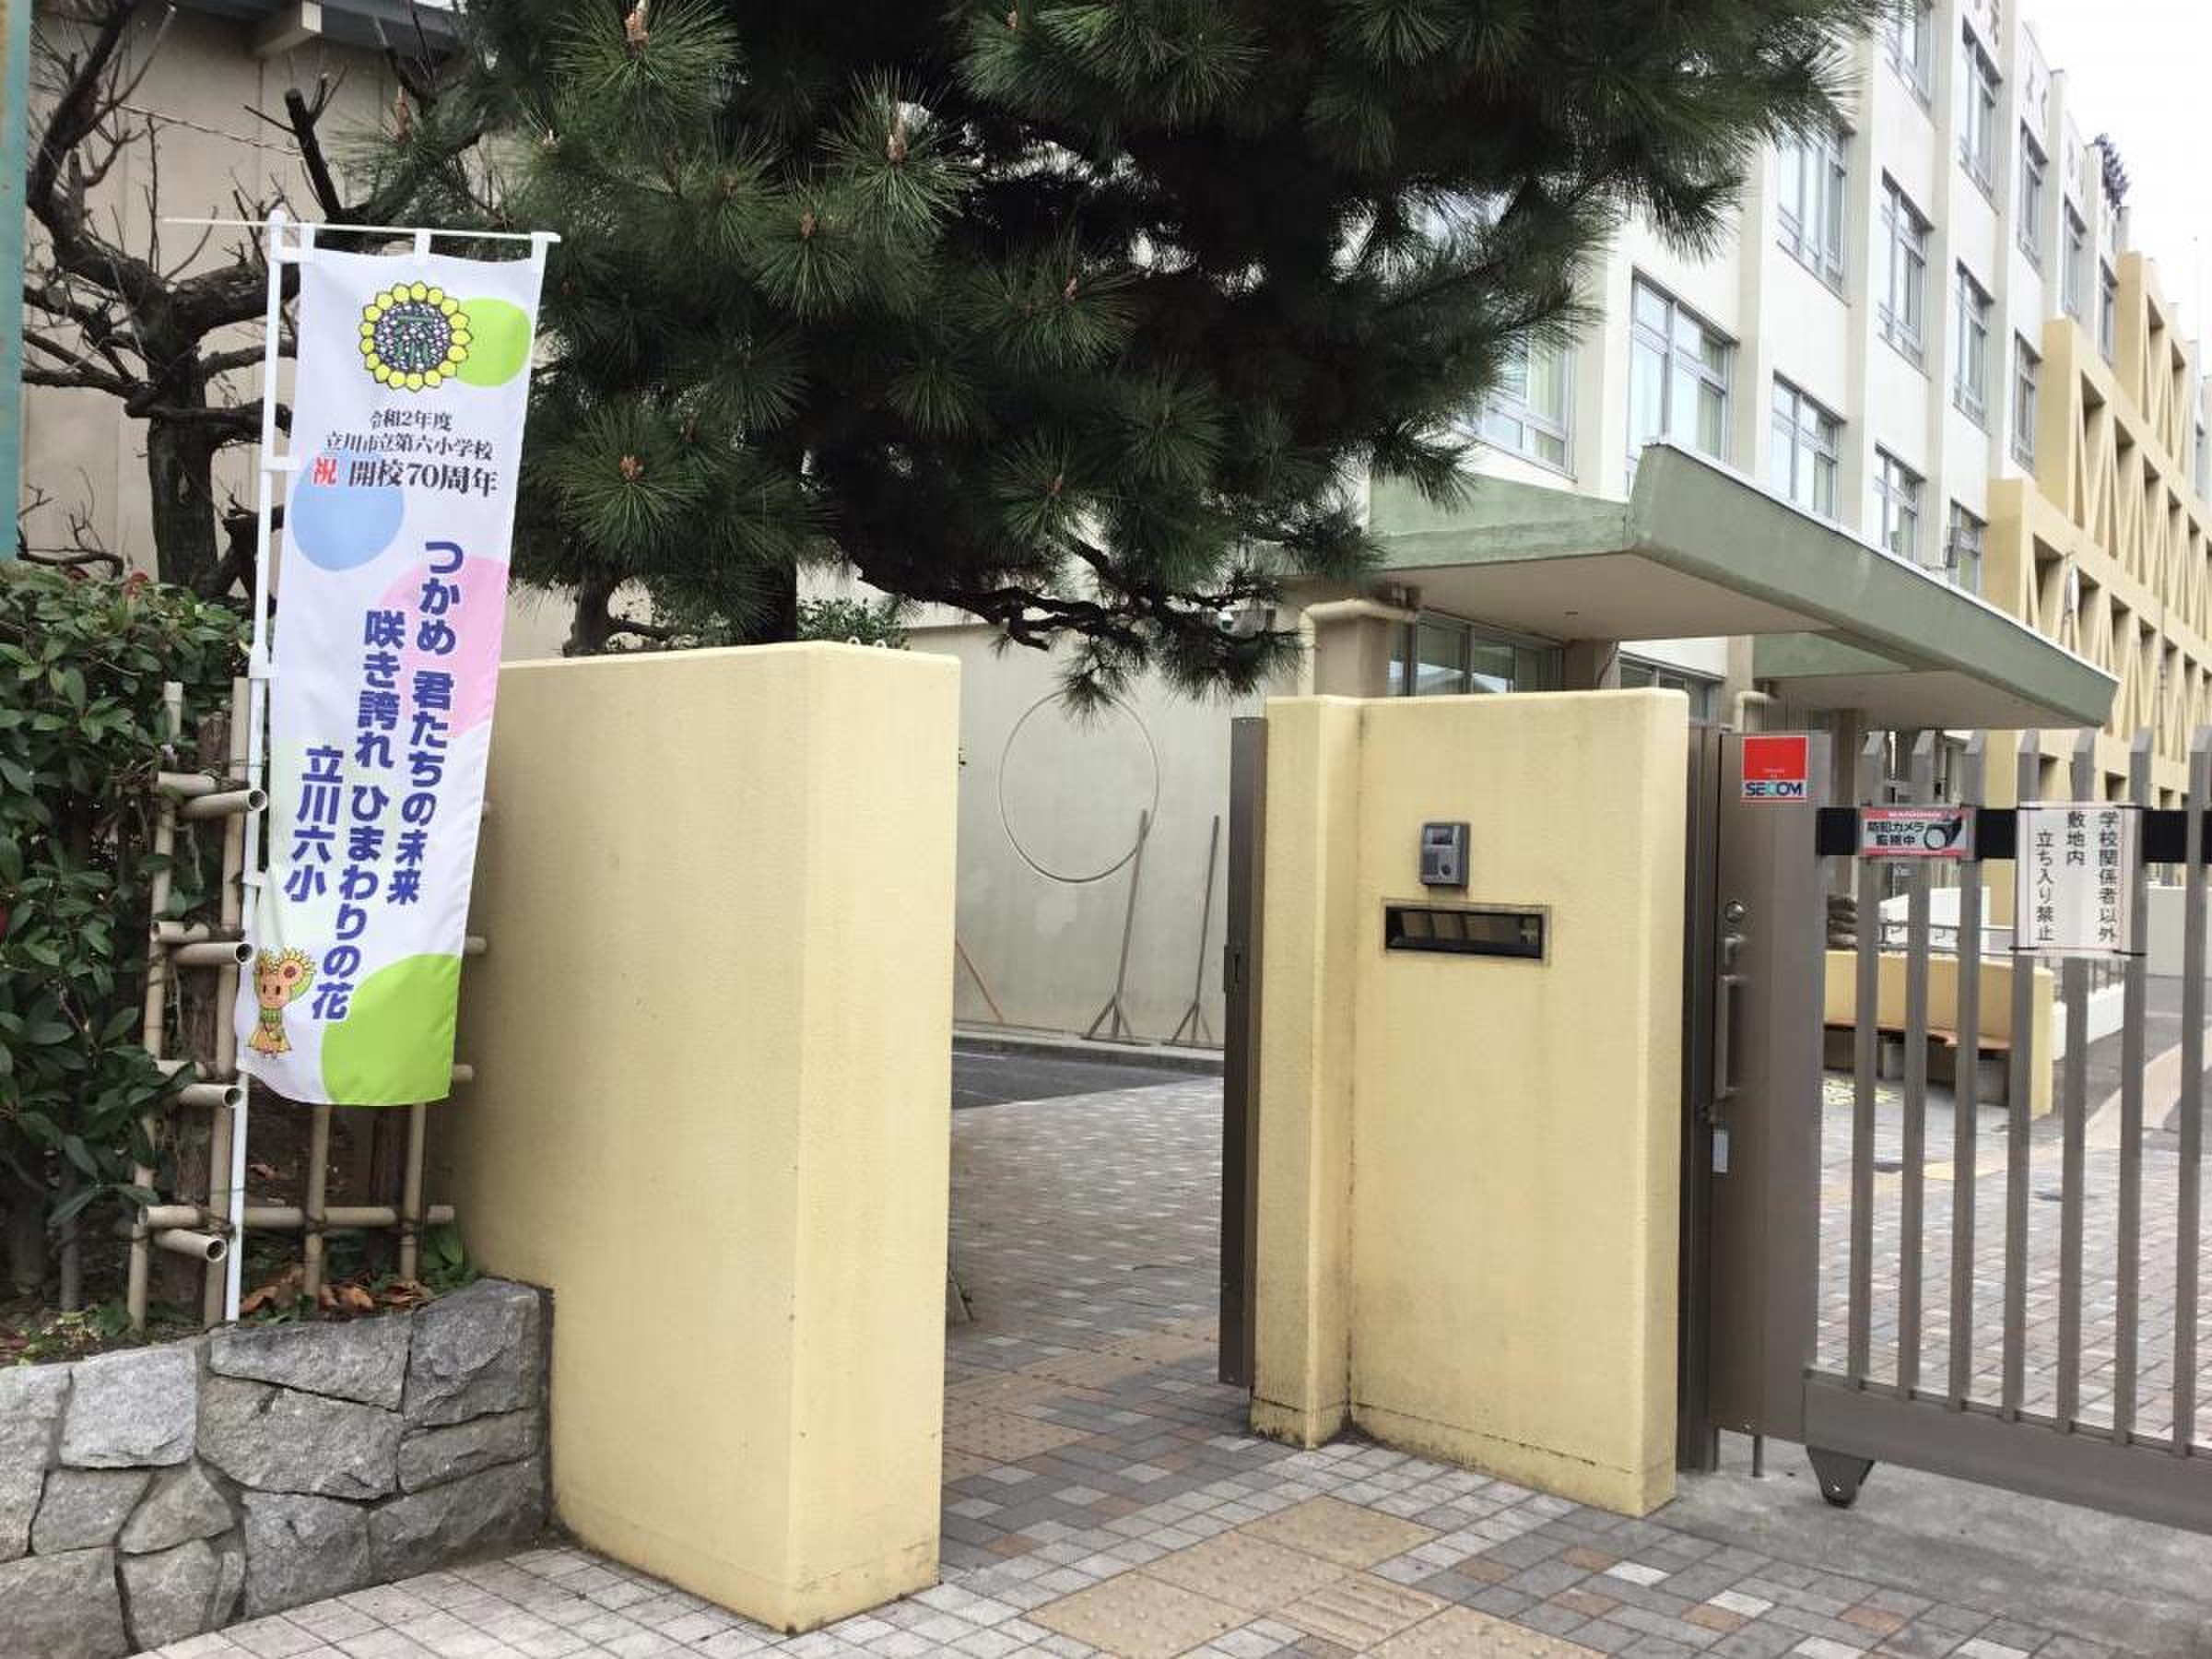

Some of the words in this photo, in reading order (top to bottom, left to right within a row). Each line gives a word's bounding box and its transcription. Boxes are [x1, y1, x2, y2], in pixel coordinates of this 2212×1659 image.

[371, 408, 453, 431] 令和2年度
[326, 430, 493, 460] 立川市立第六小学校
[312, 457, 337, 485] 祝
[1745, 782, 1802, 796] SECOM
[284, 745, 344, 902] 立川六小
[2065, 810, 2086, 866] 敷地内
[2035, 830, 2054, 941] 立ち入り禁止
[2098, 811, 2119, 942] 学校関係者以外
